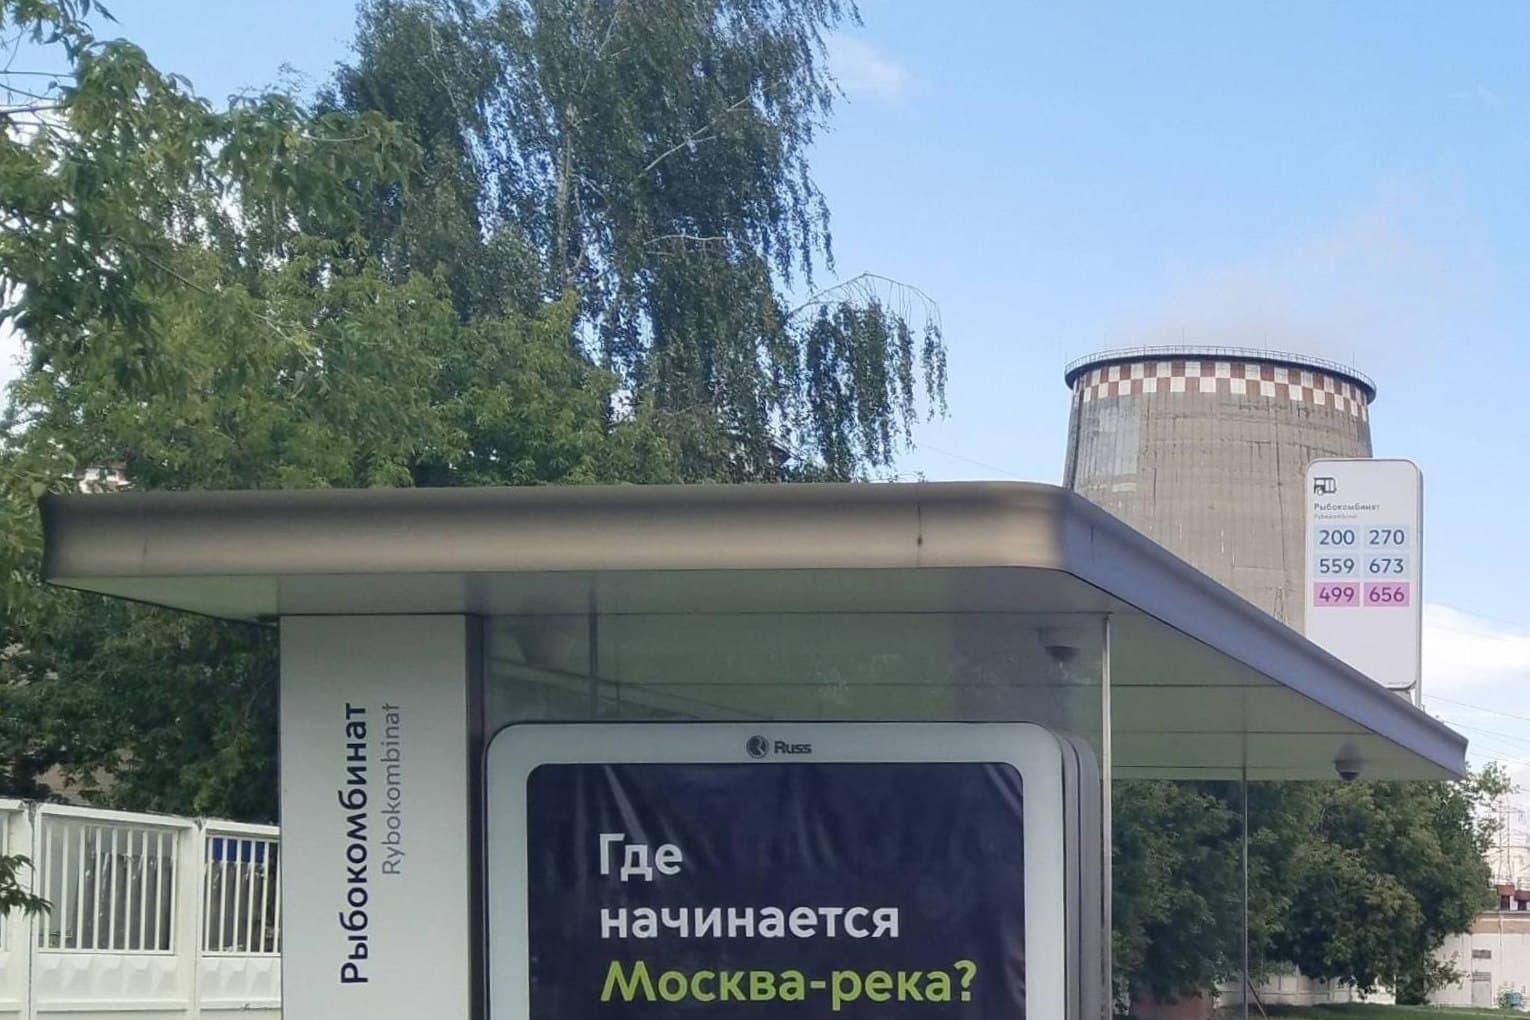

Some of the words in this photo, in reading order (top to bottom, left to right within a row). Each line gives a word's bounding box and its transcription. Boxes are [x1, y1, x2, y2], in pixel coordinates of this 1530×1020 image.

[1319, 529, 1355, 545] 200
[1369, 529, 1405, 545] 270
[1319, 558, 1355, 574] 559
[1369, 558, 1404, 574] 673
[1319, 586, 1355, 603] 499
[1369, 586, 1405, 603] 656
[774, 740, 812, 754] Russ
[380, 703, 405, 875] Rybokombinat
[338, 703, 369, 984] Рыбокомбинат
[600, 833, 683, 882] Где
[600, 906, 900, 939] начинается
[600, 959, 977, 1011] Москва-река?
